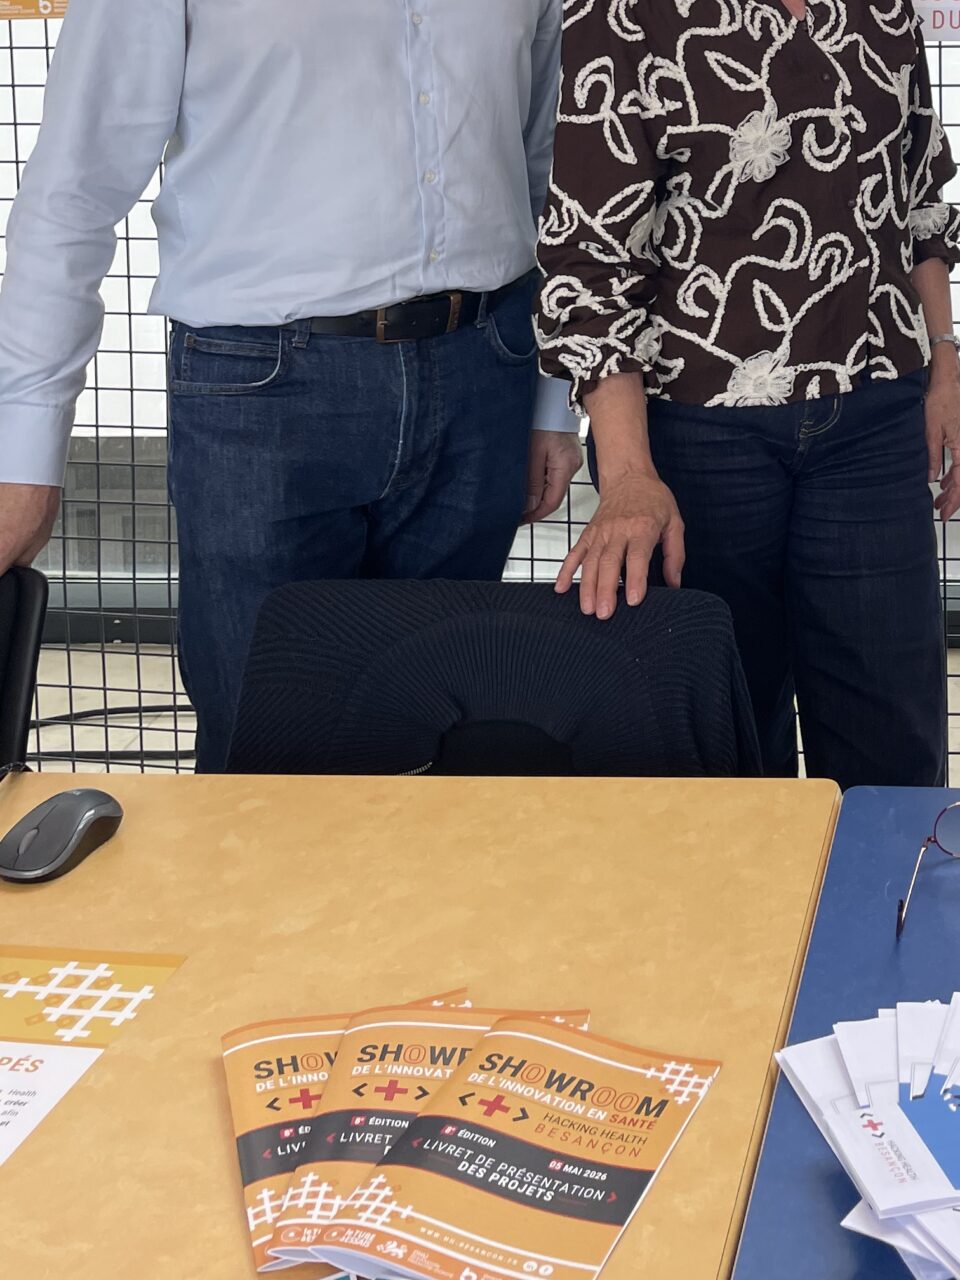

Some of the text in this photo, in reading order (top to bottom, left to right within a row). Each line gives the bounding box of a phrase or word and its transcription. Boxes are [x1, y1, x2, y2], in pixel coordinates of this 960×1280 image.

[351, 1064, 370, 1075] DE
[255, 1079, 276, 1093] DE
[478, 1052, 670, 1119] SHOWROOM
[467, 1073, 657, 1131] DE L'INNOVATION EN SANTÉ
[368, 1117, 410, 1129] ÉDITION
[542, 1111, 648, 1145] HACKING HEALTH
[339, 1132, 393, 1145] LIVRET
[457, 1128, 497, 1148] ÉDITION
[534, 1125, 642, 1157] BESANÇON
[423, 1138, 607, 1201] LIVRET DE PRÉSENTATION
[549, 1160, 563, 1170] 05
[562, 1163, 583, 1175] MAI
[456, 1160, 556, 1202] DES PROJETS
